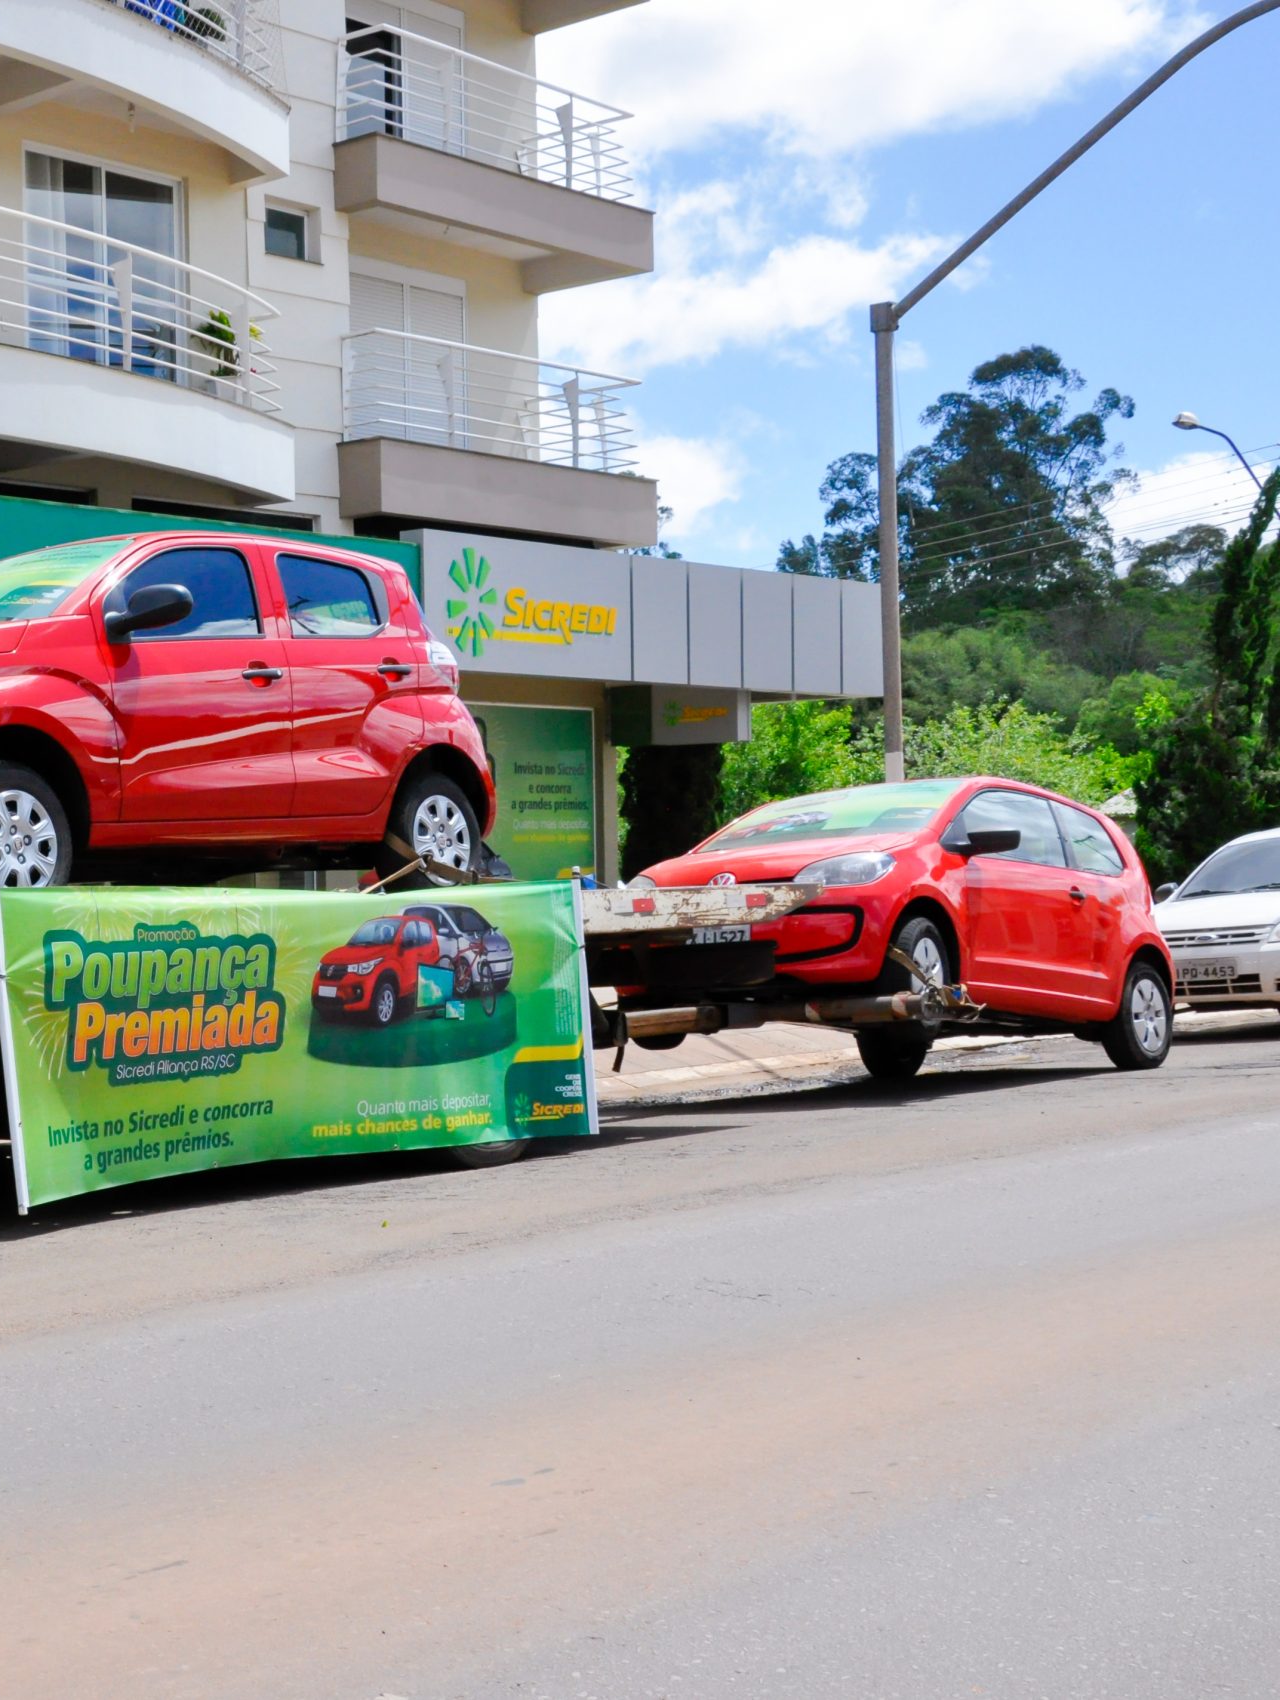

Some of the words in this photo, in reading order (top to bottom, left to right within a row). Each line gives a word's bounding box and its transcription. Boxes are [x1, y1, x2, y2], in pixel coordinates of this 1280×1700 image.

[503, 587, 617, 644] SICREDI
[514, 762, 543, 775] Invista
[545, 766, 556, 775] no
[529, 785, 534, 794] e
[536, 785, 572, 794] concorra
[511, 801, 517, 809] a
[518, 797, 552, 813] grandes
[137, 928, 197, 943] Promoção
[51, 941, 270, 1008] Poupança
[74, 991, 280, 1062] Premiada
[116, 1061, 155, 1079] Sicredi
[157, 1057, 198, 1076] Aliança
[200, 1054, 236, 1071] RS/SC
[357, 1099, 406, 1118] Quanto
[409, 1095, 439, 1112] mais
[442, 1092, 492, 1111] depositar,
[48, 1120, 99, 1147] Invista
[104, 1118, 124, 1137] no
[129, 1104, 185, 1134] Sicredi
[189, 1108, 199, 1124] e
[203, 1099, 274, 1122] concorra
[312, 1119, 352, 1138] mais
[356, 1116, 417, 1136] chances
[422, 1114, 442, 1130] de
[446, 1110, 493, 1132] ganhar.
[84, 1153, 93, 1171] a
[97, 1139, 160, 1174] grandes
[164, 1130, 235, 1162] prêmios.
